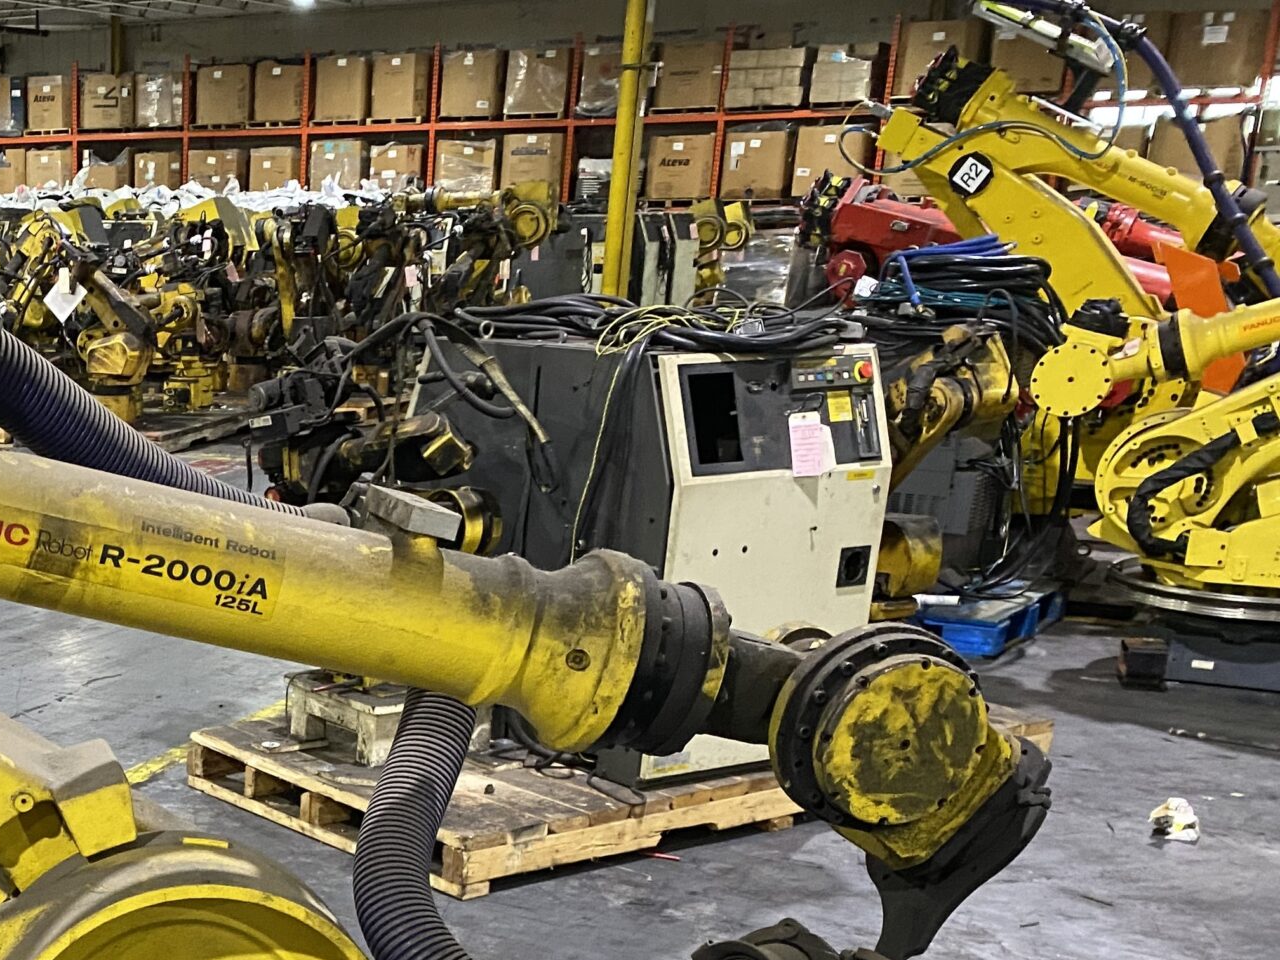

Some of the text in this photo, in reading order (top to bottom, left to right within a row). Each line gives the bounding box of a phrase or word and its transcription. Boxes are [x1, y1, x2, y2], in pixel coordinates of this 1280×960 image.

[960, 162, 983, 188] R2
[140, 520, 277, 561] Intelligent Robot
[35, 528, 95, 562] Robot
[98, 543, 269, 601] R-2000iA
[213, 592, 264, 616] 125L
